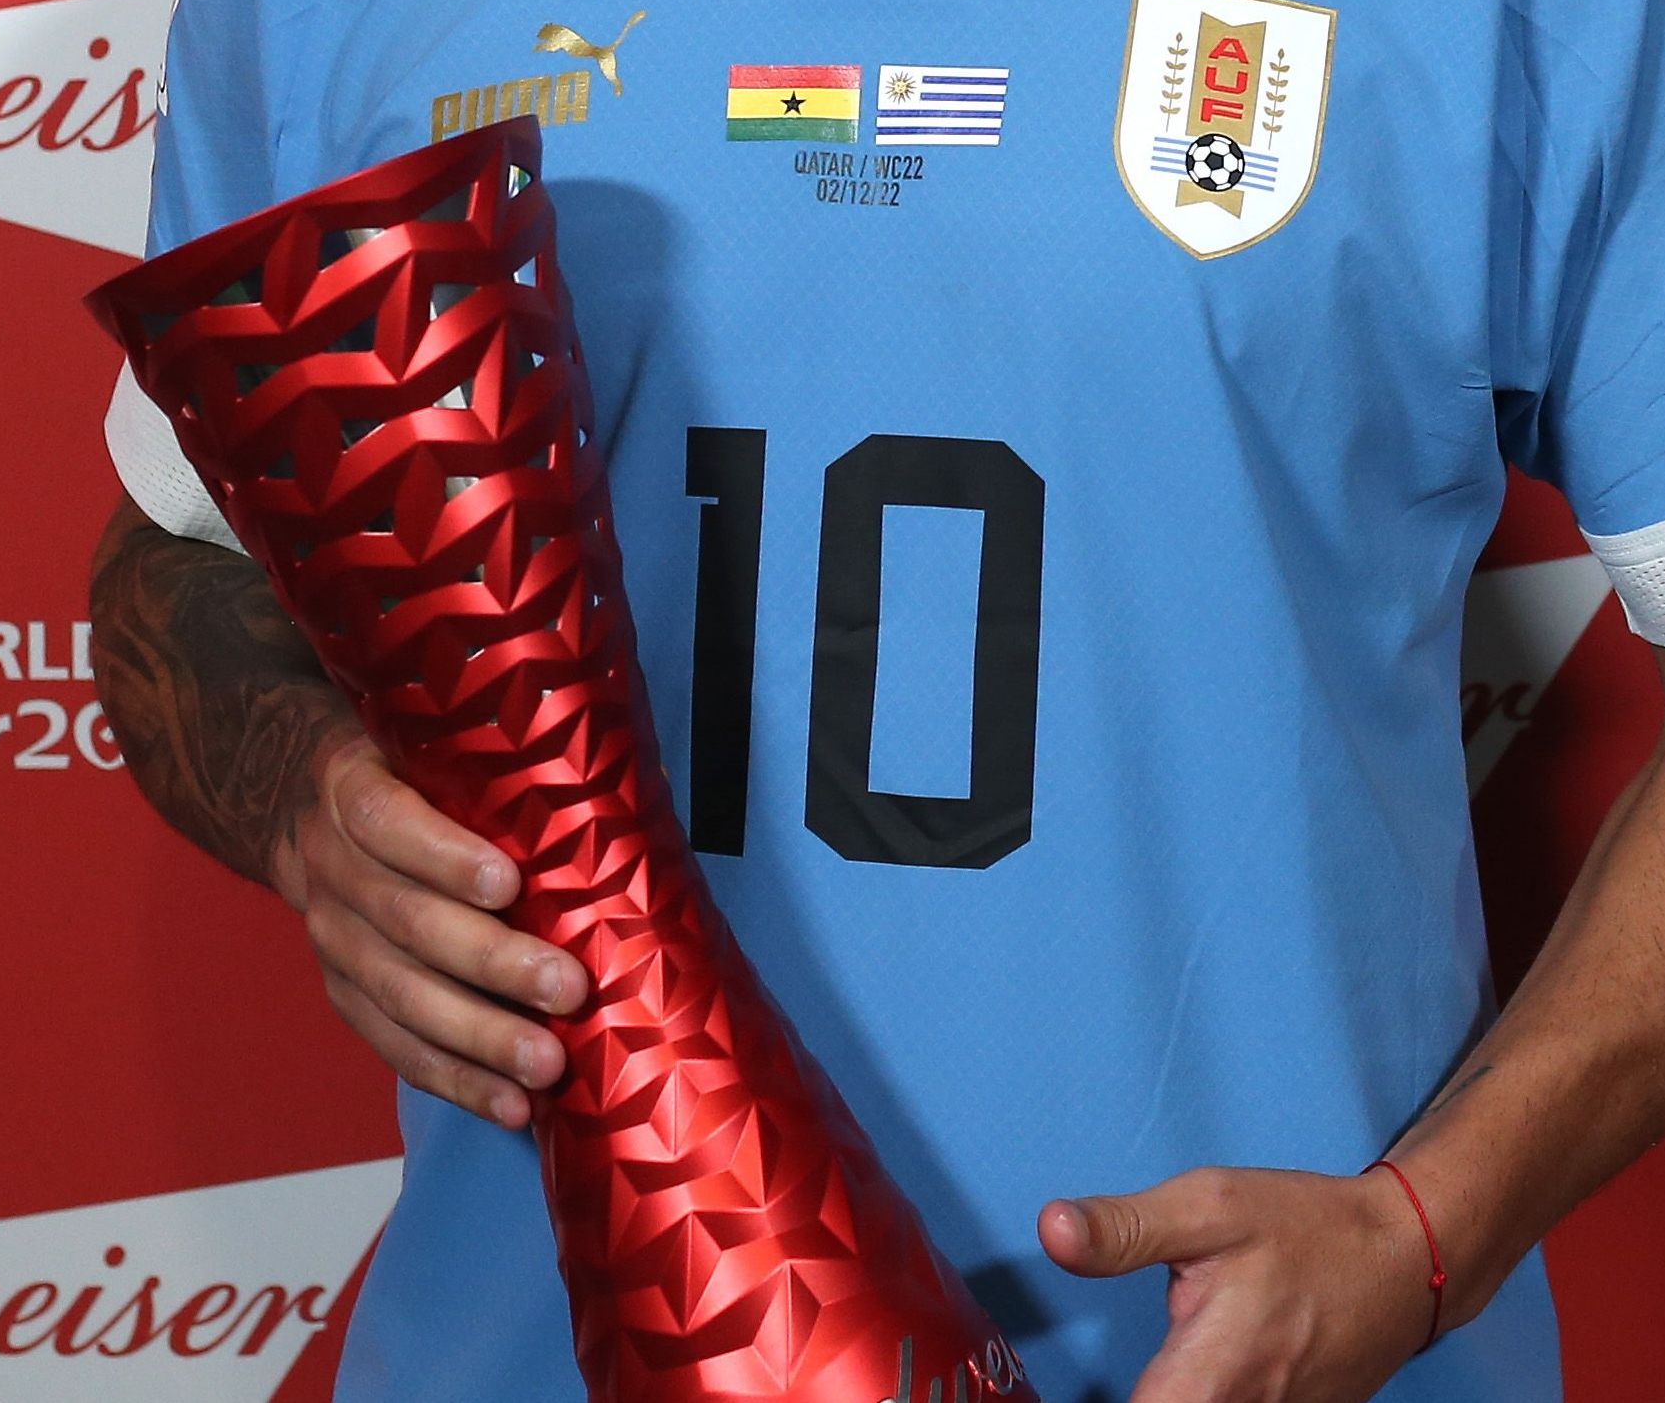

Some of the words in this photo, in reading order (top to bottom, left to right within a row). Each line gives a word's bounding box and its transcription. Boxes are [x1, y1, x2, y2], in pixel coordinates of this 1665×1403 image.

[432, 70, 589, 146] PUMA
[1201, 37, 1250, 123] AUF
[794, 150, 854, 178] QATAR
[876, 155, 924, 180] WC22
[817, 178, 901, 207] 02/12/22
[685, 426, 1045, 870] 10
